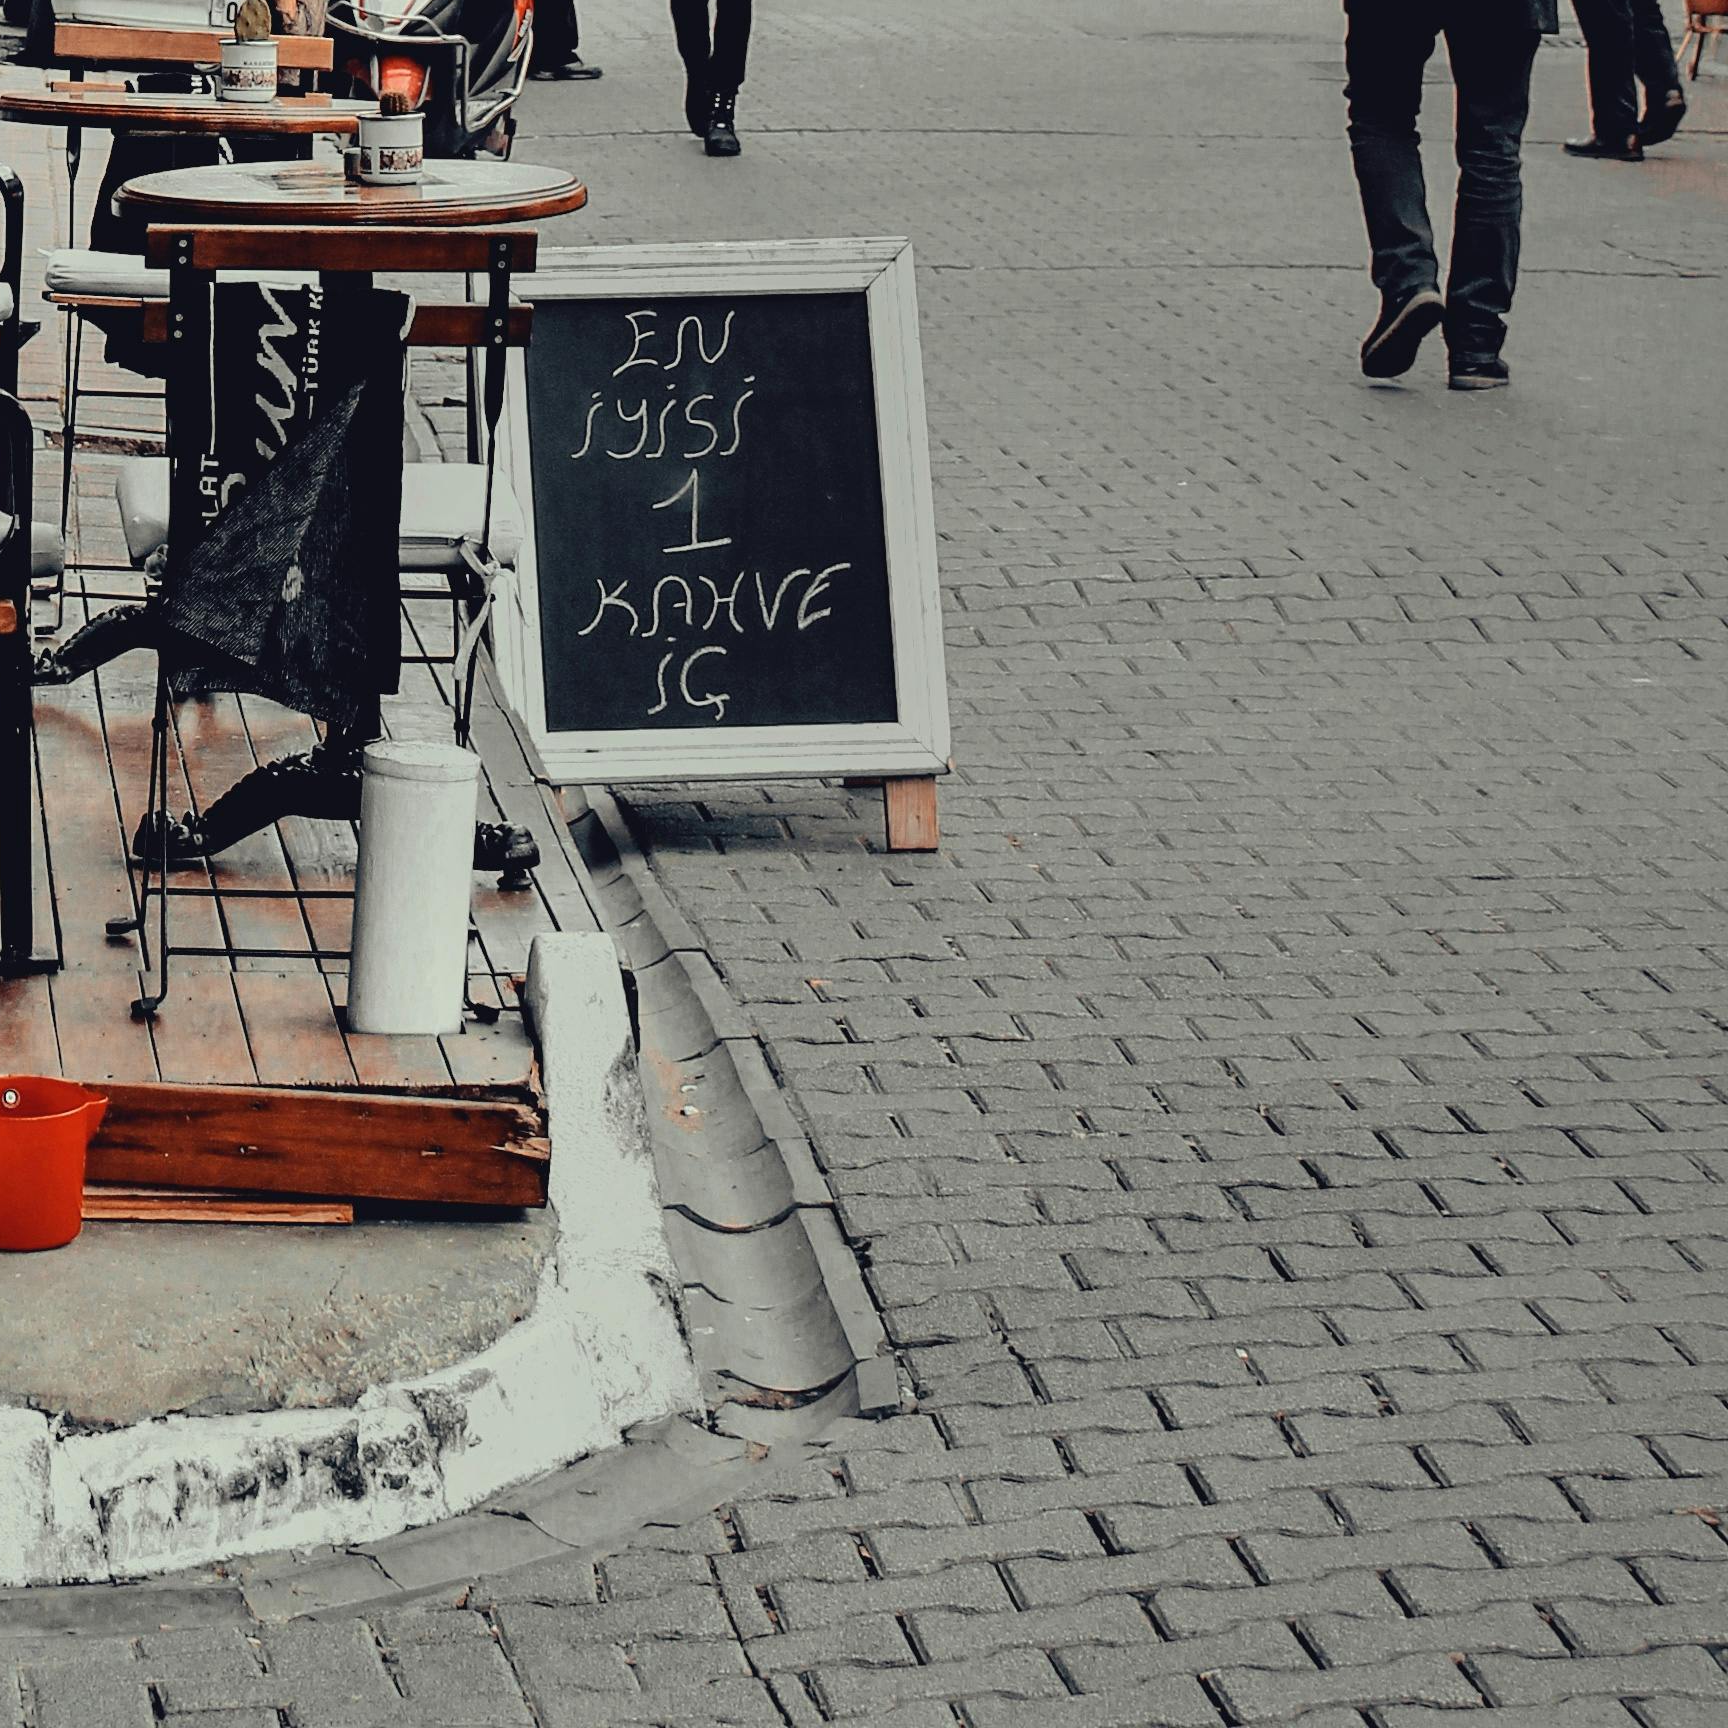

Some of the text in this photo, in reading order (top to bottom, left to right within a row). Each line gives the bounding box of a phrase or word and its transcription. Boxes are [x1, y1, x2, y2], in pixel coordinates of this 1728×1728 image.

[611, 309, 736, 378] EN
[198, 453, 221, 526] LAT
[651, 466, 733, 555] 1
[577, 562, 852, 639] KAHVE
